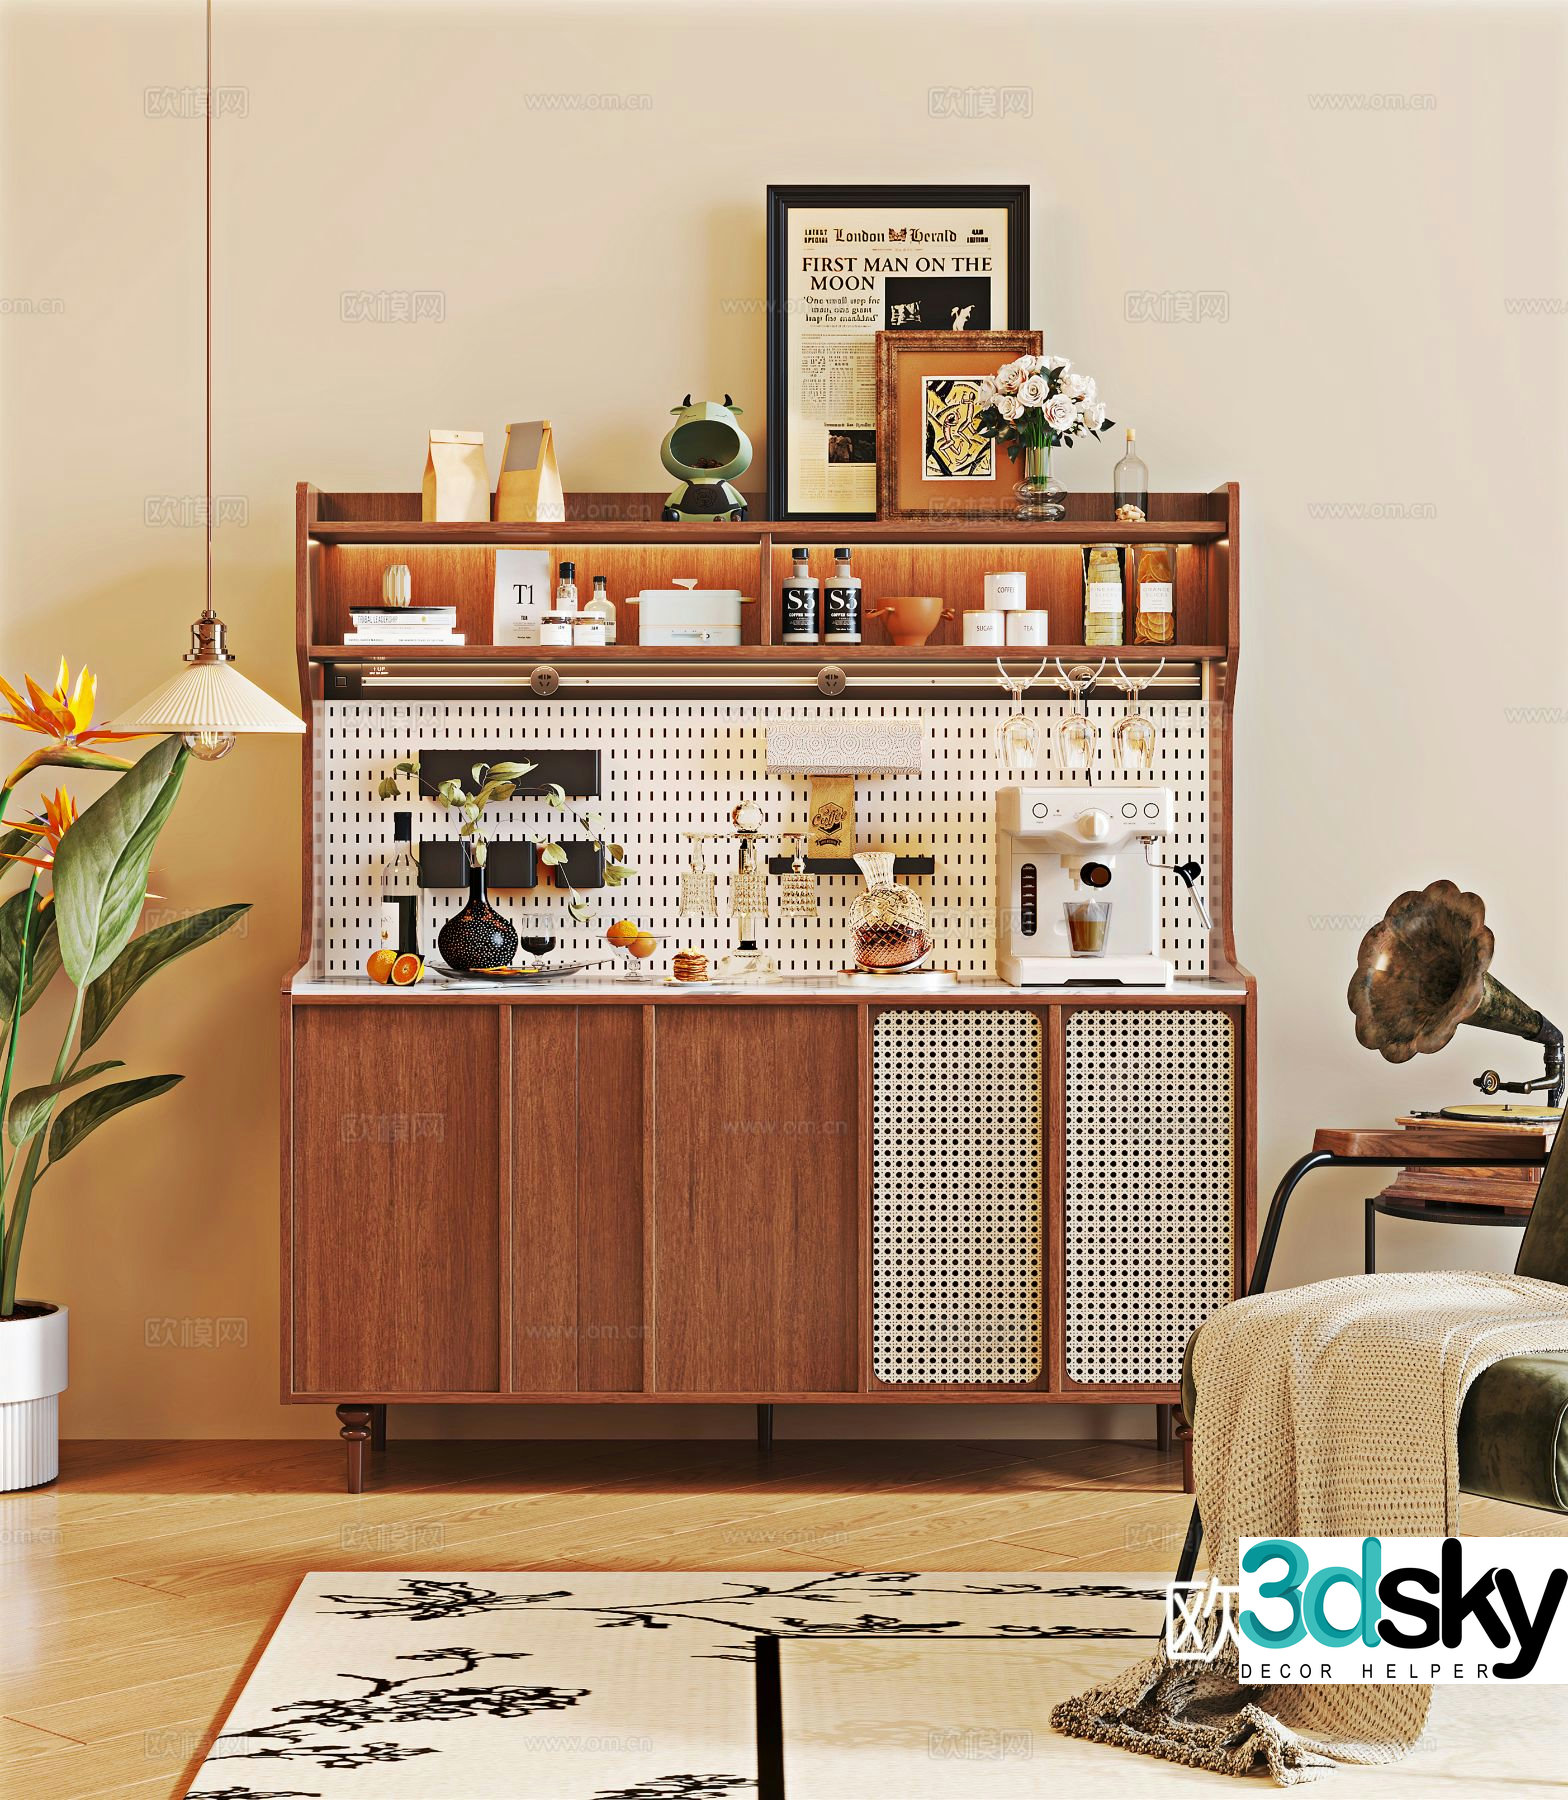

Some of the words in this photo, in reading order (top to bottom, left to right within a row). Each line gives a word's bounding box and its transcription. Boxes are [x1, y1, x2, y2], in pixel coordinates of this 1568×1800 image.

[834, 228, 885, 243] London
[909, 228, 957, 244] Herald
[802, 257, 857, 272] FIRST
[864, 257, 909, 272] MAN
[916, 257, 946, 272] ON
[952, 257, 993, 272] THE
[810, 275, 875, 291] MOON
[512, 584, 535, 605] T1
[997, 586, 1016, 594] COFFEE
[787, 589, 816, 610] S3
[829, 589, 858, 610] S3
[812, 808, 848, 827] Coffee
